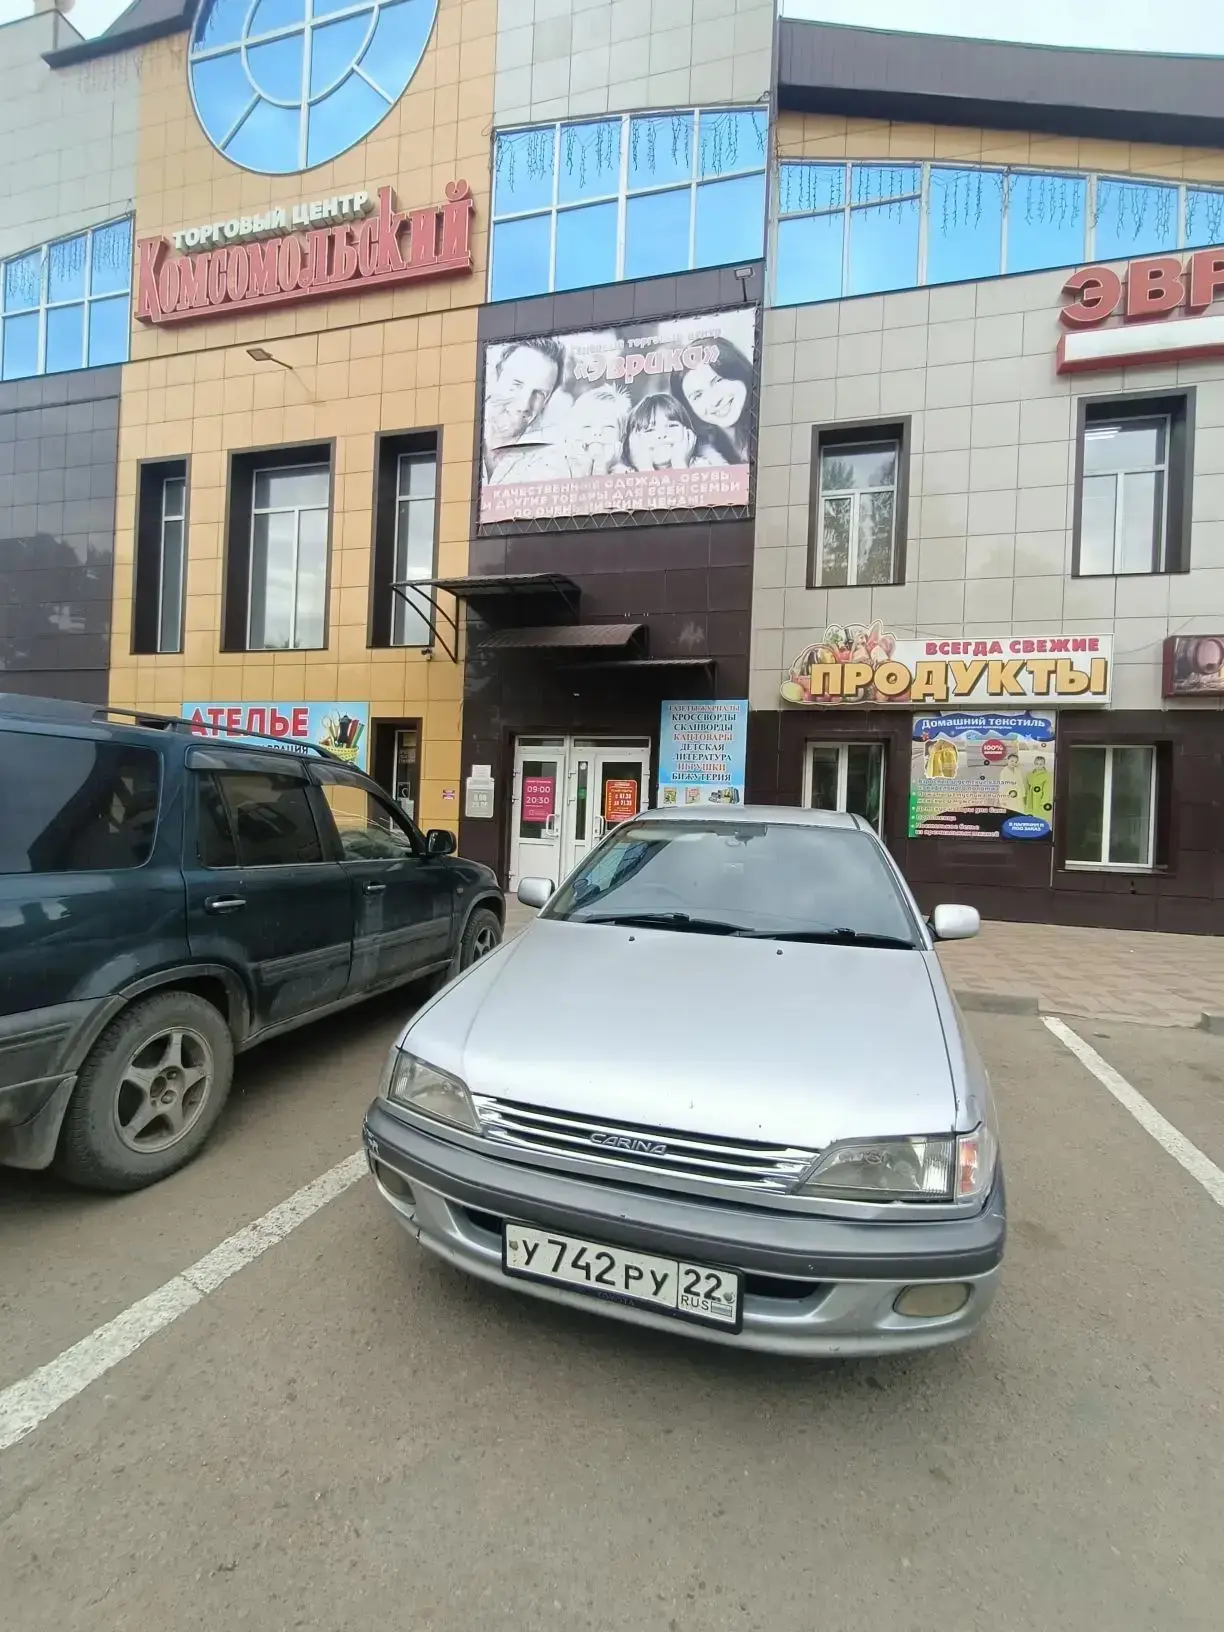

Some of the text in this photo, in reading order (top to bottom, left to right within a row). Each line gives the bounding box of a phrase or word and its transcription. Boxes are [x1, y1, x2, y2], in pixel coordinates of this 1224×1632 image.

[172, 190, 370, 250] ТОРГОВЫЙ ЦЕНТР
[482, 481, 741, 511] И ДРУГИЕ ТОВАРЫ ДЛЯ ВСЕЙ СЕМЬИ
[536, 503, 580, 516] ОЧЕНЬ
[925, 637, 1100, 656] ВСЕГДА СВЕЖИЕ
[810, 658, 1108, 702] ПРОДУКТЫ
[191, 707, 309, 737] АТЕЛЬЕ
[672, 713, 737, 721] КРОССВОРДЫ
[921, 716, 986, 730] Домашний
[989, 717, 1046, 727] текстиль
[673, 723, 733, 731] СКАНВОРДЫ
[680, 743, 725, 751] ДЕТСКАЯ
[673, 753, 732, 761] ЛИТЕРАТУРА
[672, 772, 731, 781] БИЖУТЕРИЯ
[527, 785, 551, 793] 09:00
[526, 796, 550, 804] 20:30
[589, 1132, 668, 1156] CARINA
[683, 1268, 723, 1301] 22
[681, 1295, 710, 1311] RUS
